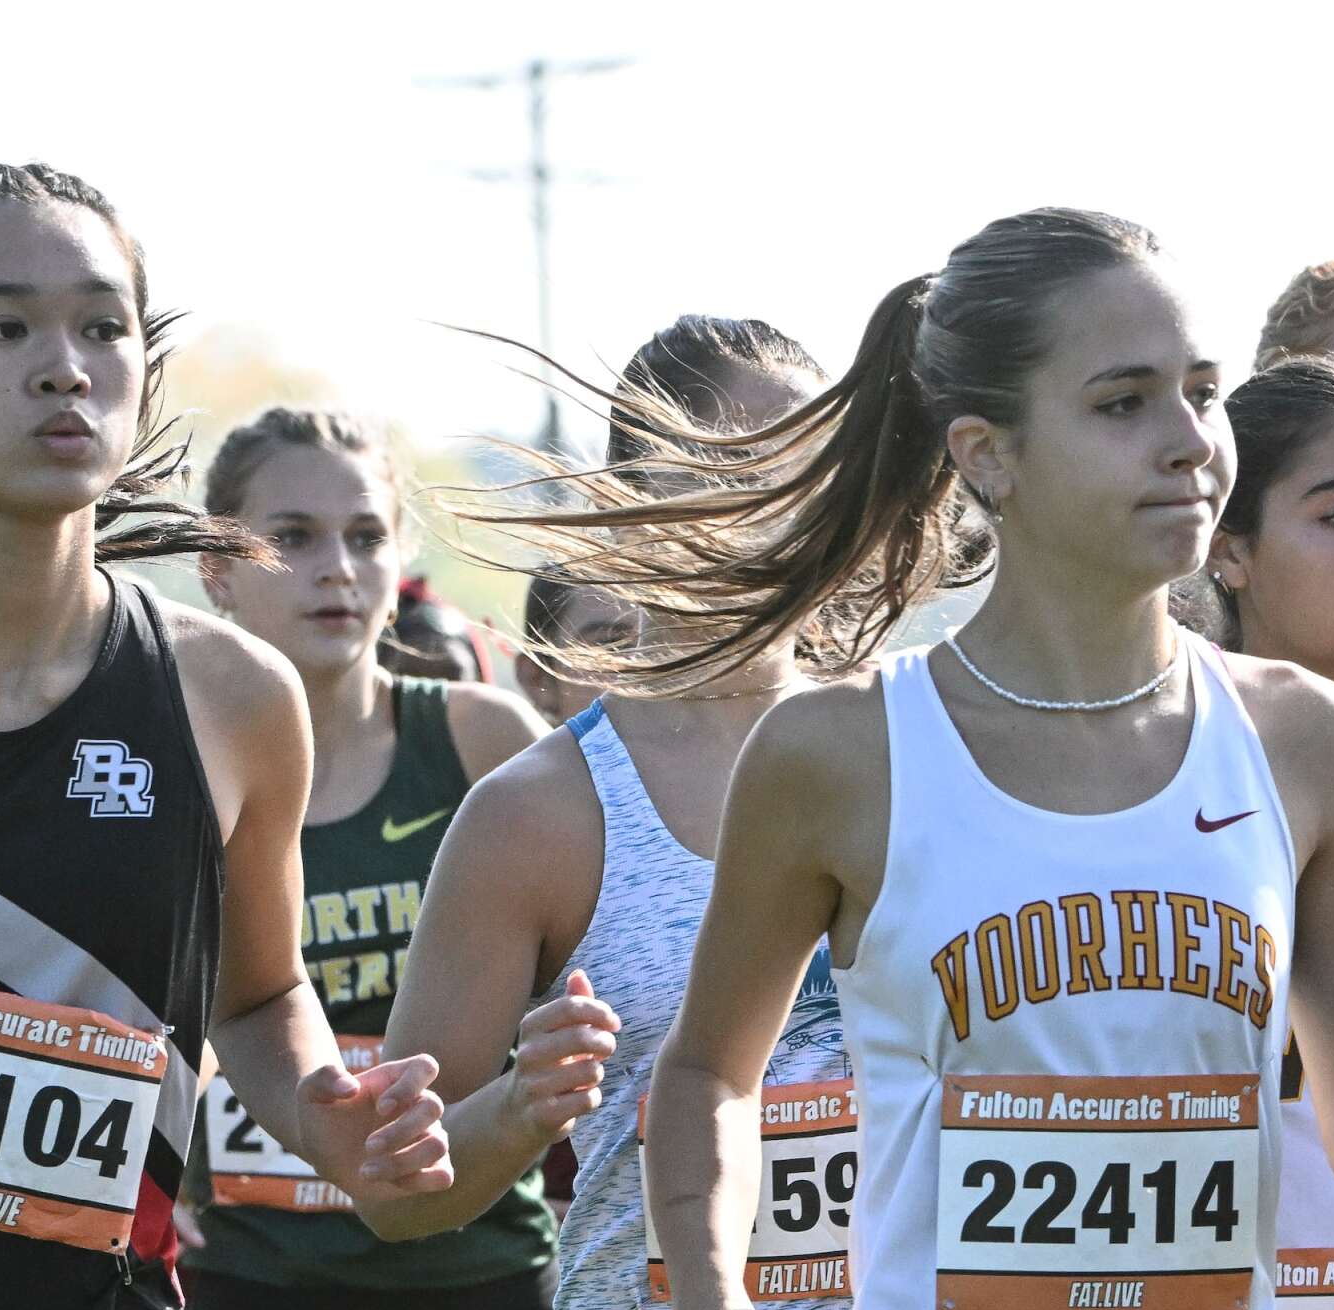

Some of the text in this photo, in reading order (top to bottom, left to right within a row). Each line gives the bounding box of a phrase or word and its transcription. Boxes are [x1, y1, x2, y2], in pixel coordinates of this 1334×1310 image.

[67, 740, 155, 818] BR
[301, 881, 422, 947] RTH
[931, 889, 1277, 1043] VOORHEES
[76, 1024, 158, 1071] Timing
[961, 1090, 1241, 1123] Fulton Accurate Timing
[960, 1159, 1239, 1244] 22414
[758, 1259, 845, 1294] FAT.LIVE
[1068, 1281, 1145, 1309] FAT.LIVE
